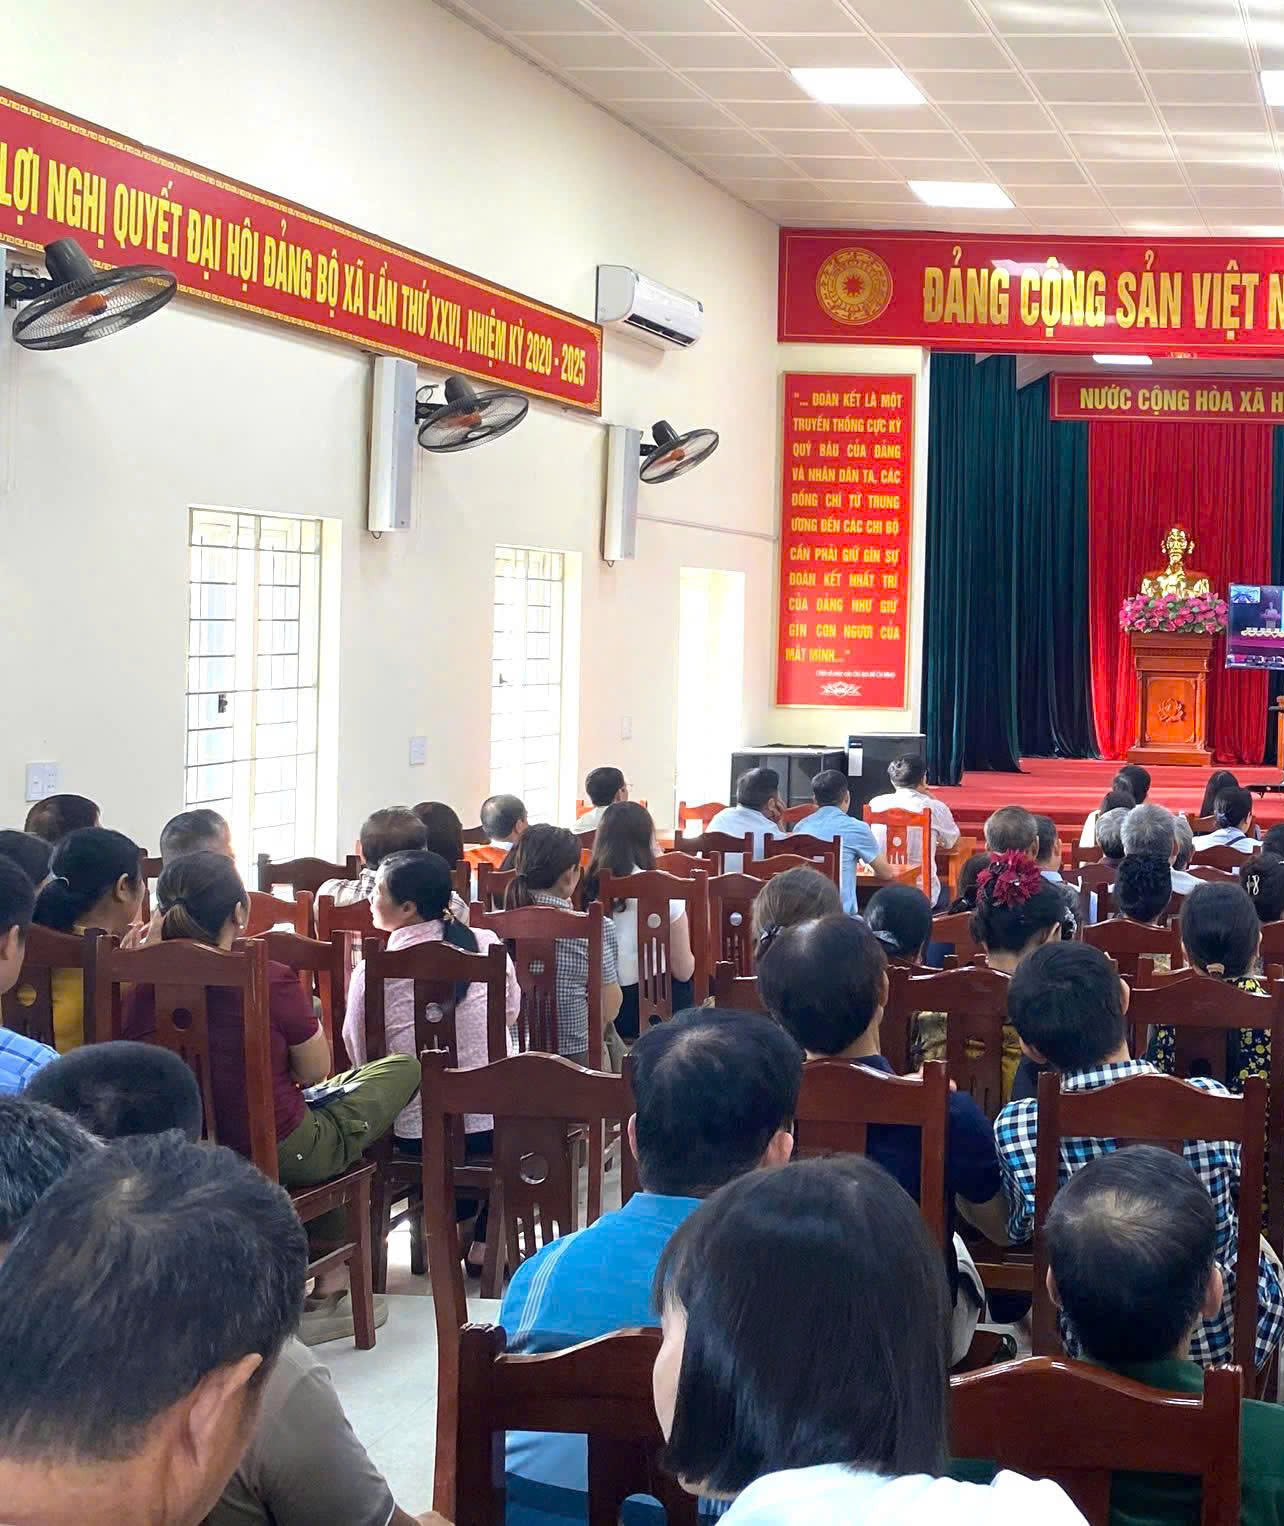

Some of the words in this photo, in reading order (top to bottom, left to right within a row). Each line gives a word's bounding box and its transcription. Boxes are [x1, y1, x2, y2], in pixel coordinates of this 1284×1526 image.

[47, 160, 106, 248] NGHỊ
[114, 181, 182, 257] QUYẾT
[187, 208, 221, 280] ĐẠI
[228, 218, 259, 292] HỘI
[264, 219, 311, 299] ĐẢNG
[316, 249, 338, 317] BỘ
[343, 261, 363, 315] XÃ
[368, 262, 397, 326] LẦN
[401, 280, 430, 336] THỨ
[430, 296, 463, 353] XXVI,
[467, 308, 507, 367] NHIỆM
[509, 319, 524, 366] KỲ
[526, 331, 552, 375] 2020
[561, 344, 586, 386] 2025
[923, 246, 1009, 325] ĐẢNG
[1021, 256, 1105, 337] CỘNG
[1116, 249, 1182, 330] SẢN
[1192, 259, 1260, 340] VIỆT
[843, 389, 861, 407] KẾT
[865, 392, 877, 407] LÀ
[881, 392, 902, 410] MỘT
[1080, 384, 1131, 410] NƯỚC
[1138, 385, 1190, 415] CỘNG
[1196, 385, 1234, 412] HÒA
[1240, 388, 1264, 412] XÃ
[868, 495, 899, 509] TRUNG
[866, 520, 882, 534] CHI
